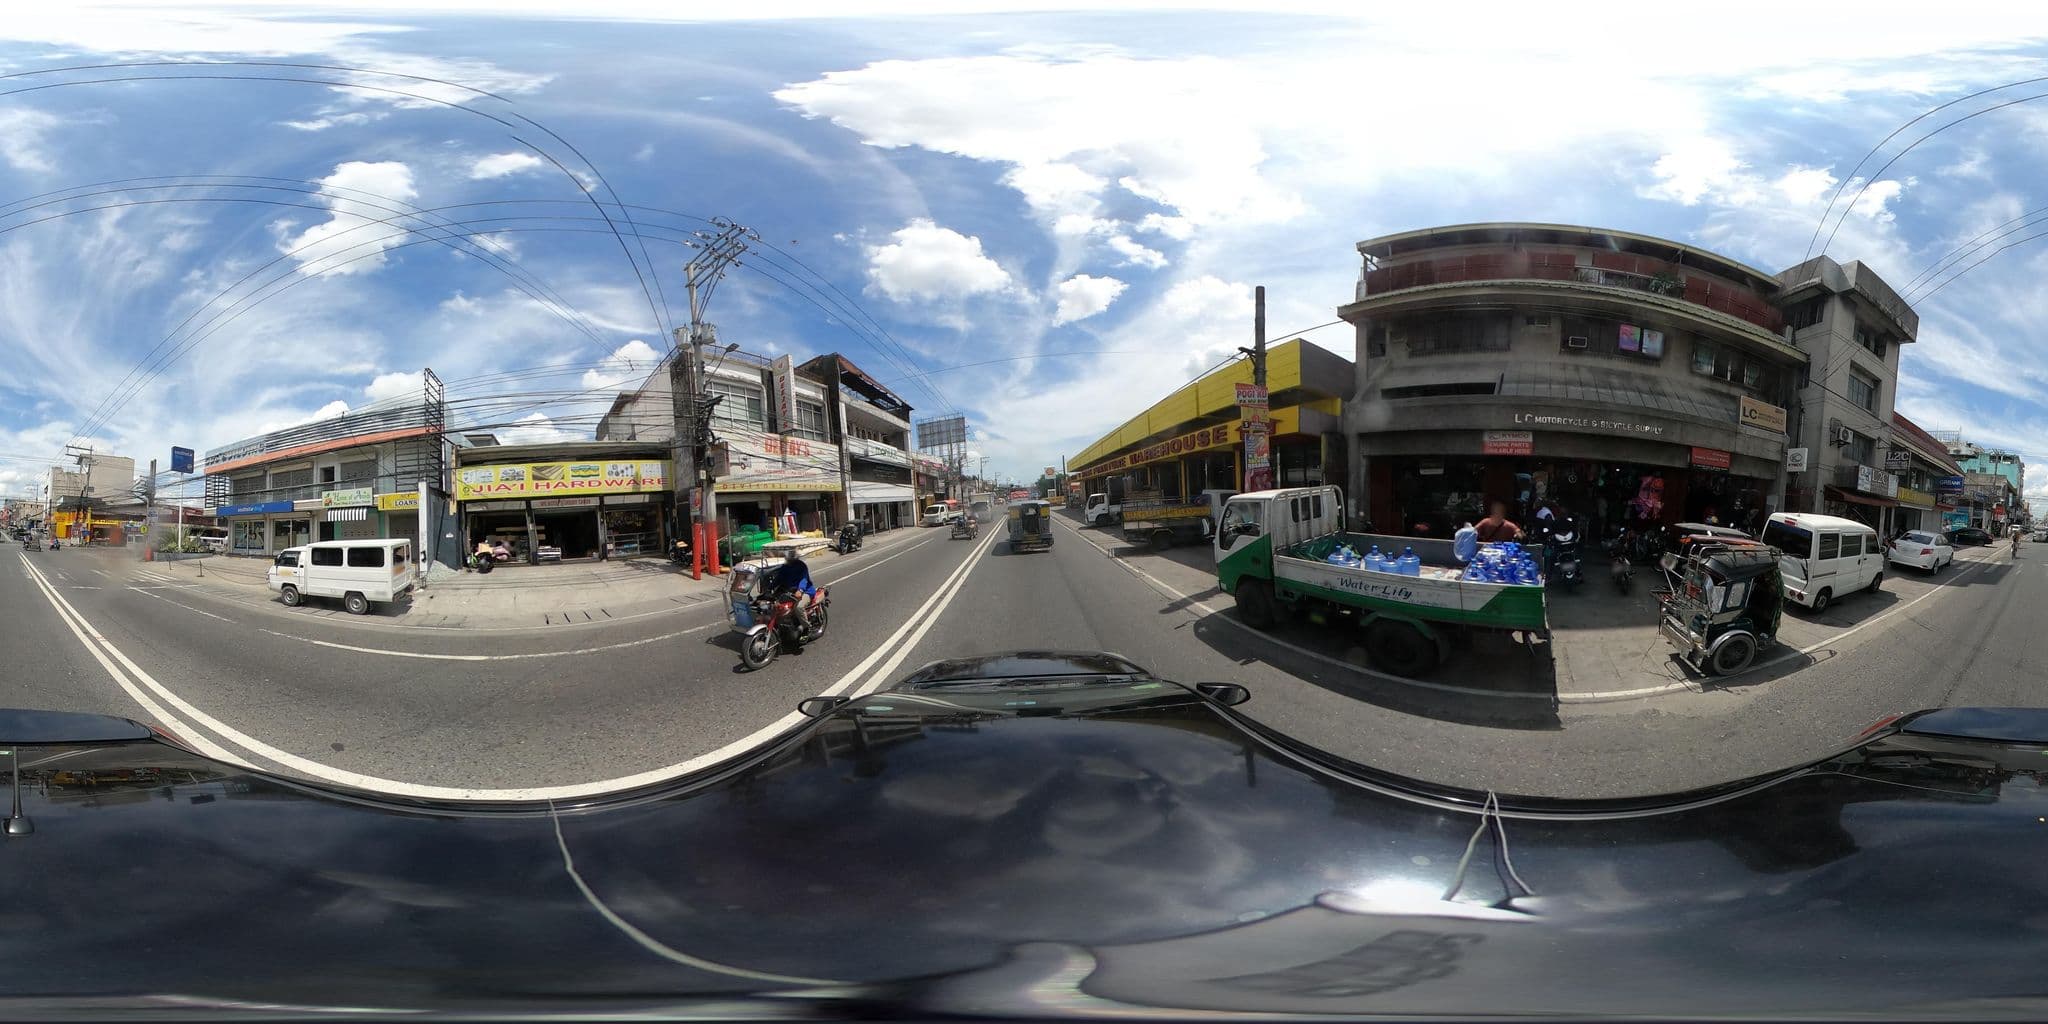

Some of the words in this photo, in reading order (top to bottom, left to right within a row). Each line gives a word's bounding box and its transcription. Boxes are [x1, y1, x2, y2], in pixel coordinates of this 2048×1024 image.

[1743, 406, 1758, 420] LC
[1534, 416, 1588, 427] MOTORCYCLE
[1600, 420, 1632, 431] BICYCLE
[1635, 424, 1663, 435] SUPPLY
[1129, 425, 1229, 465] WAREHOUSE
[1887, 451, 1909, 461] L2C
[472, 483, 524, 493] JIA'I
[534, 477, 669, 491] HARDWARE
[1872, 470, 1889, 485] L2C
